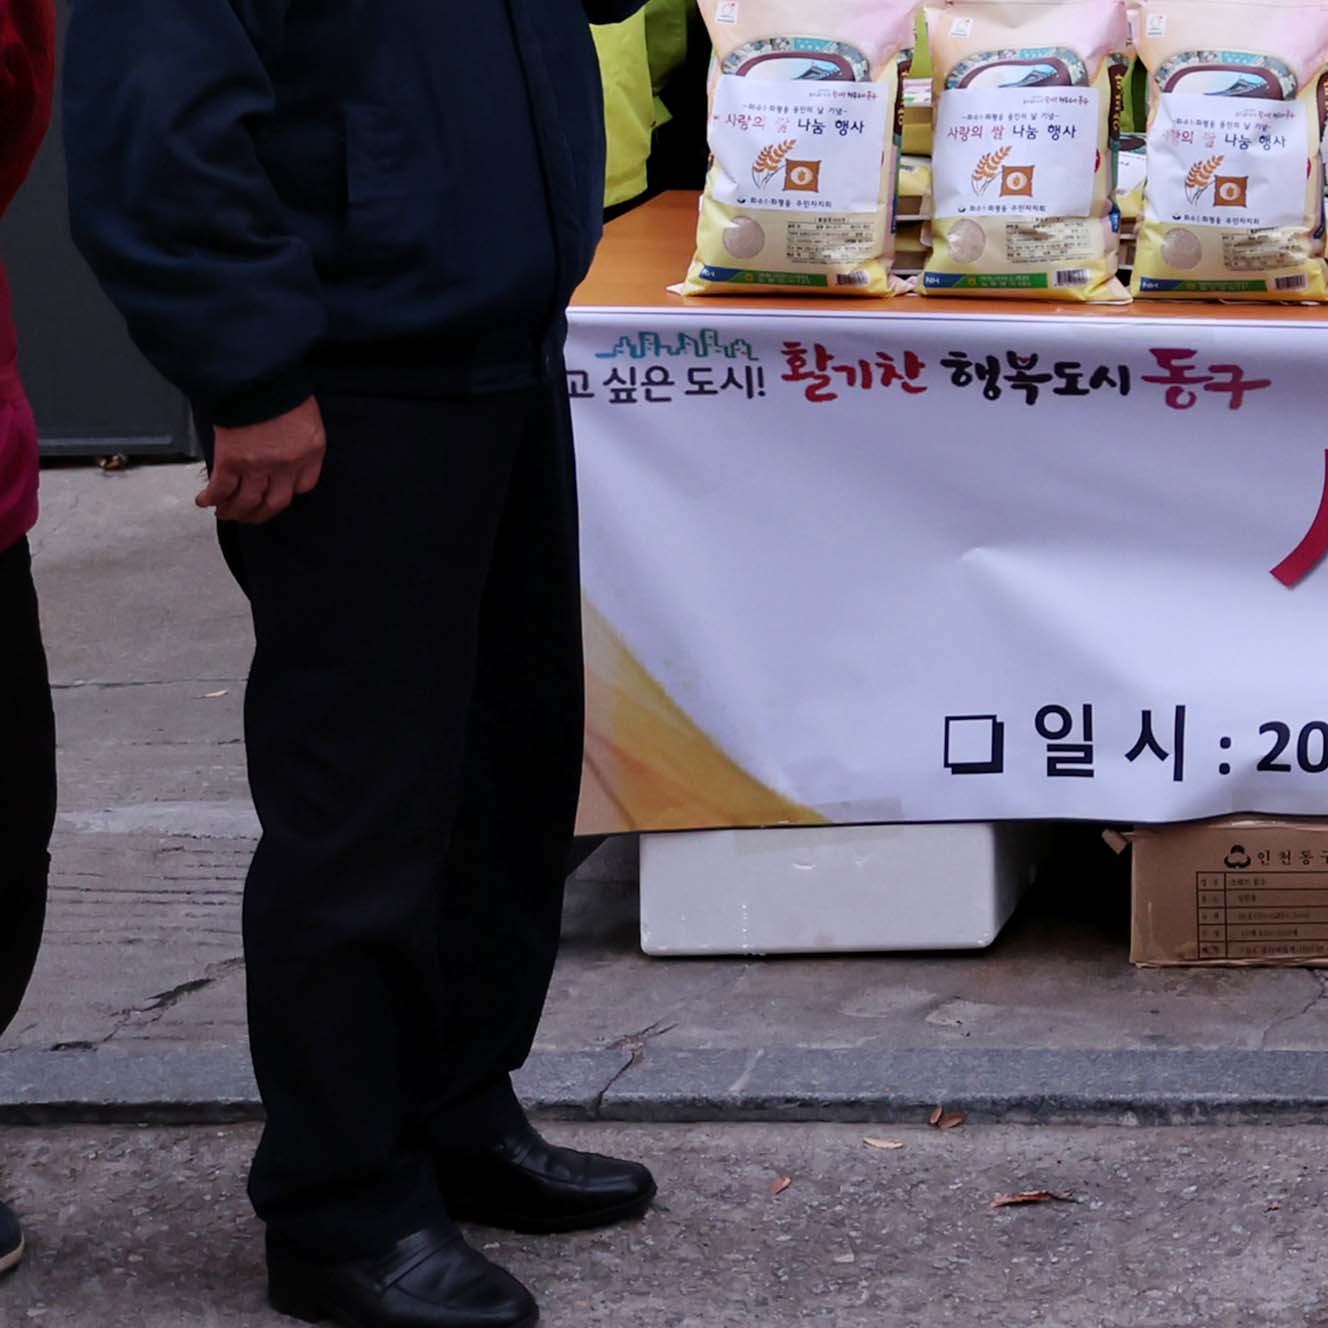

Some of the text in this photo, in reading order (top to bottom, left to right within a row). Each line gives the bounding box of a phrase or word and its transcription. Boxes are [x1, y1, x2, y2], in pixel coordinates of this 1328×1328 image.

[798, 119, 826, 135] 나눔
[834, 119, 865, 136] 행사
[947, 124, 983, 142] 사랑의
[1012, 125, 1039, 140] 나눔
[1047, 124, 1077, 141] 행사
[1225, 133, 1252, 151] 나눔
[1259, 134, 1286, 151] 행사
[603, 366, 674, 404] 싶은
[685, 365, 766, 400] 도시!
[781, 341, 927, 403] 활기찬
[940, 351, 1130, 406] 행복도시
[1141, 347, 1272, 411] 동구
[1034, 704, 1096, 777] 일
[1126, 705, 1188, 782] 시
